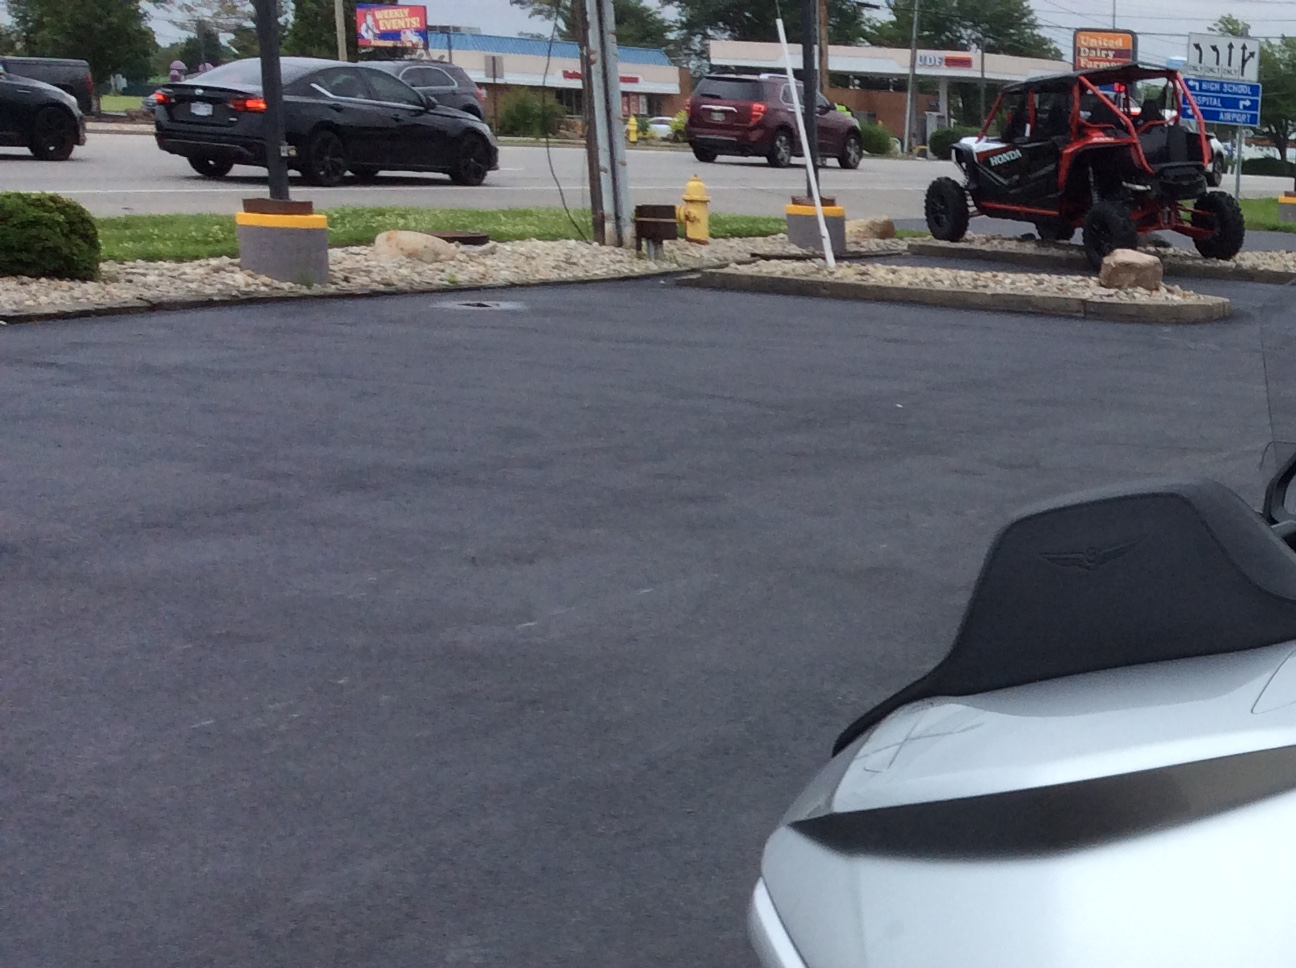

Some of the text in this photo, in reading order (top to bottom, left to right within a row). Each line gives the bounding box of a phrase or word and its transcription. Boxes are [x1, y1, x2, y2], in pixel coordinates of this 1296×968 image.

[374, 8, 410, 20] WEEKLY
[379, 17, 420, 30] EVENTS!
[1080, 35, 1123, 48] United
[1080, 47, 1115, 60] Dairy
[1202, 82, 1252, 95] HIGH SCHOOL
[1219, 112, 1251, 123] AIRPORT
[990, 149, 1022, 166] HONDA
